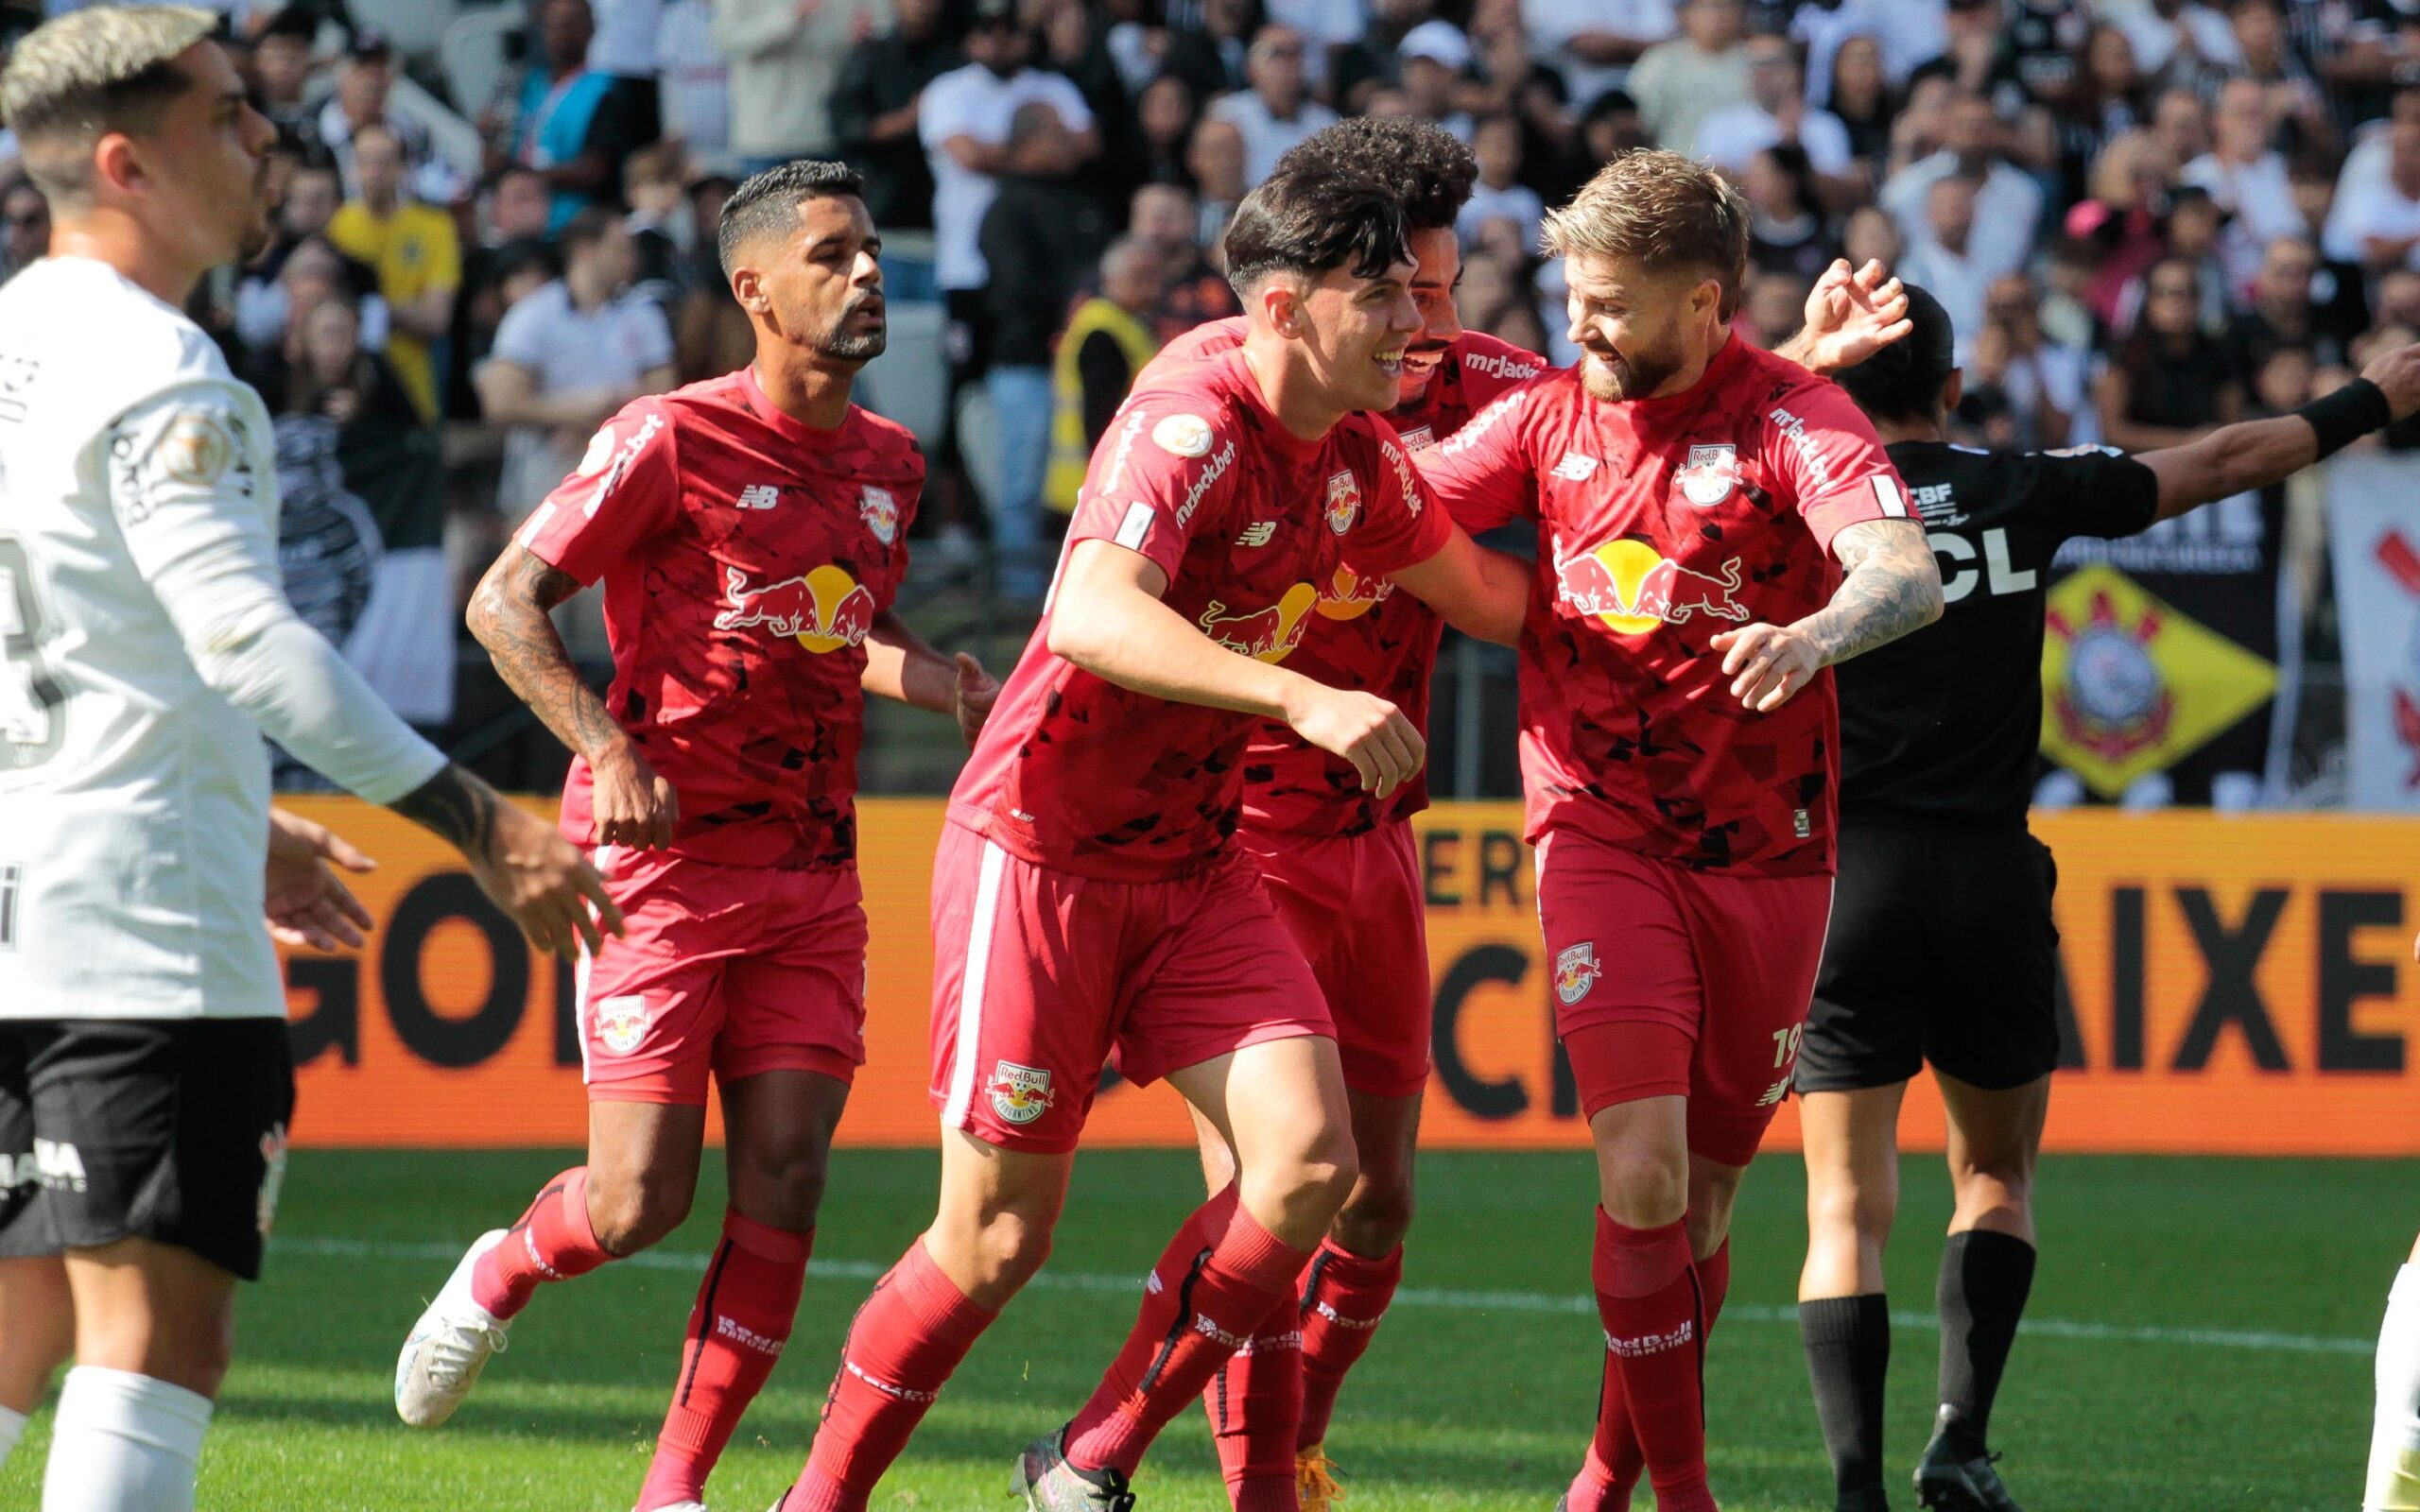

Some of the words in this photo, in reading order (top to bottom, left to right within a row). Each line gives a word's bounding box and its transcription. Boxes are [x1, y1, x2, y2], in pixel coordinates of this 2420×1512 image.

[1176, 438, 1236, 530] mrJack.bet
[1772, 1022, 1802, 1069] 19
[999, 1066, 1046, 1086] RedBull
